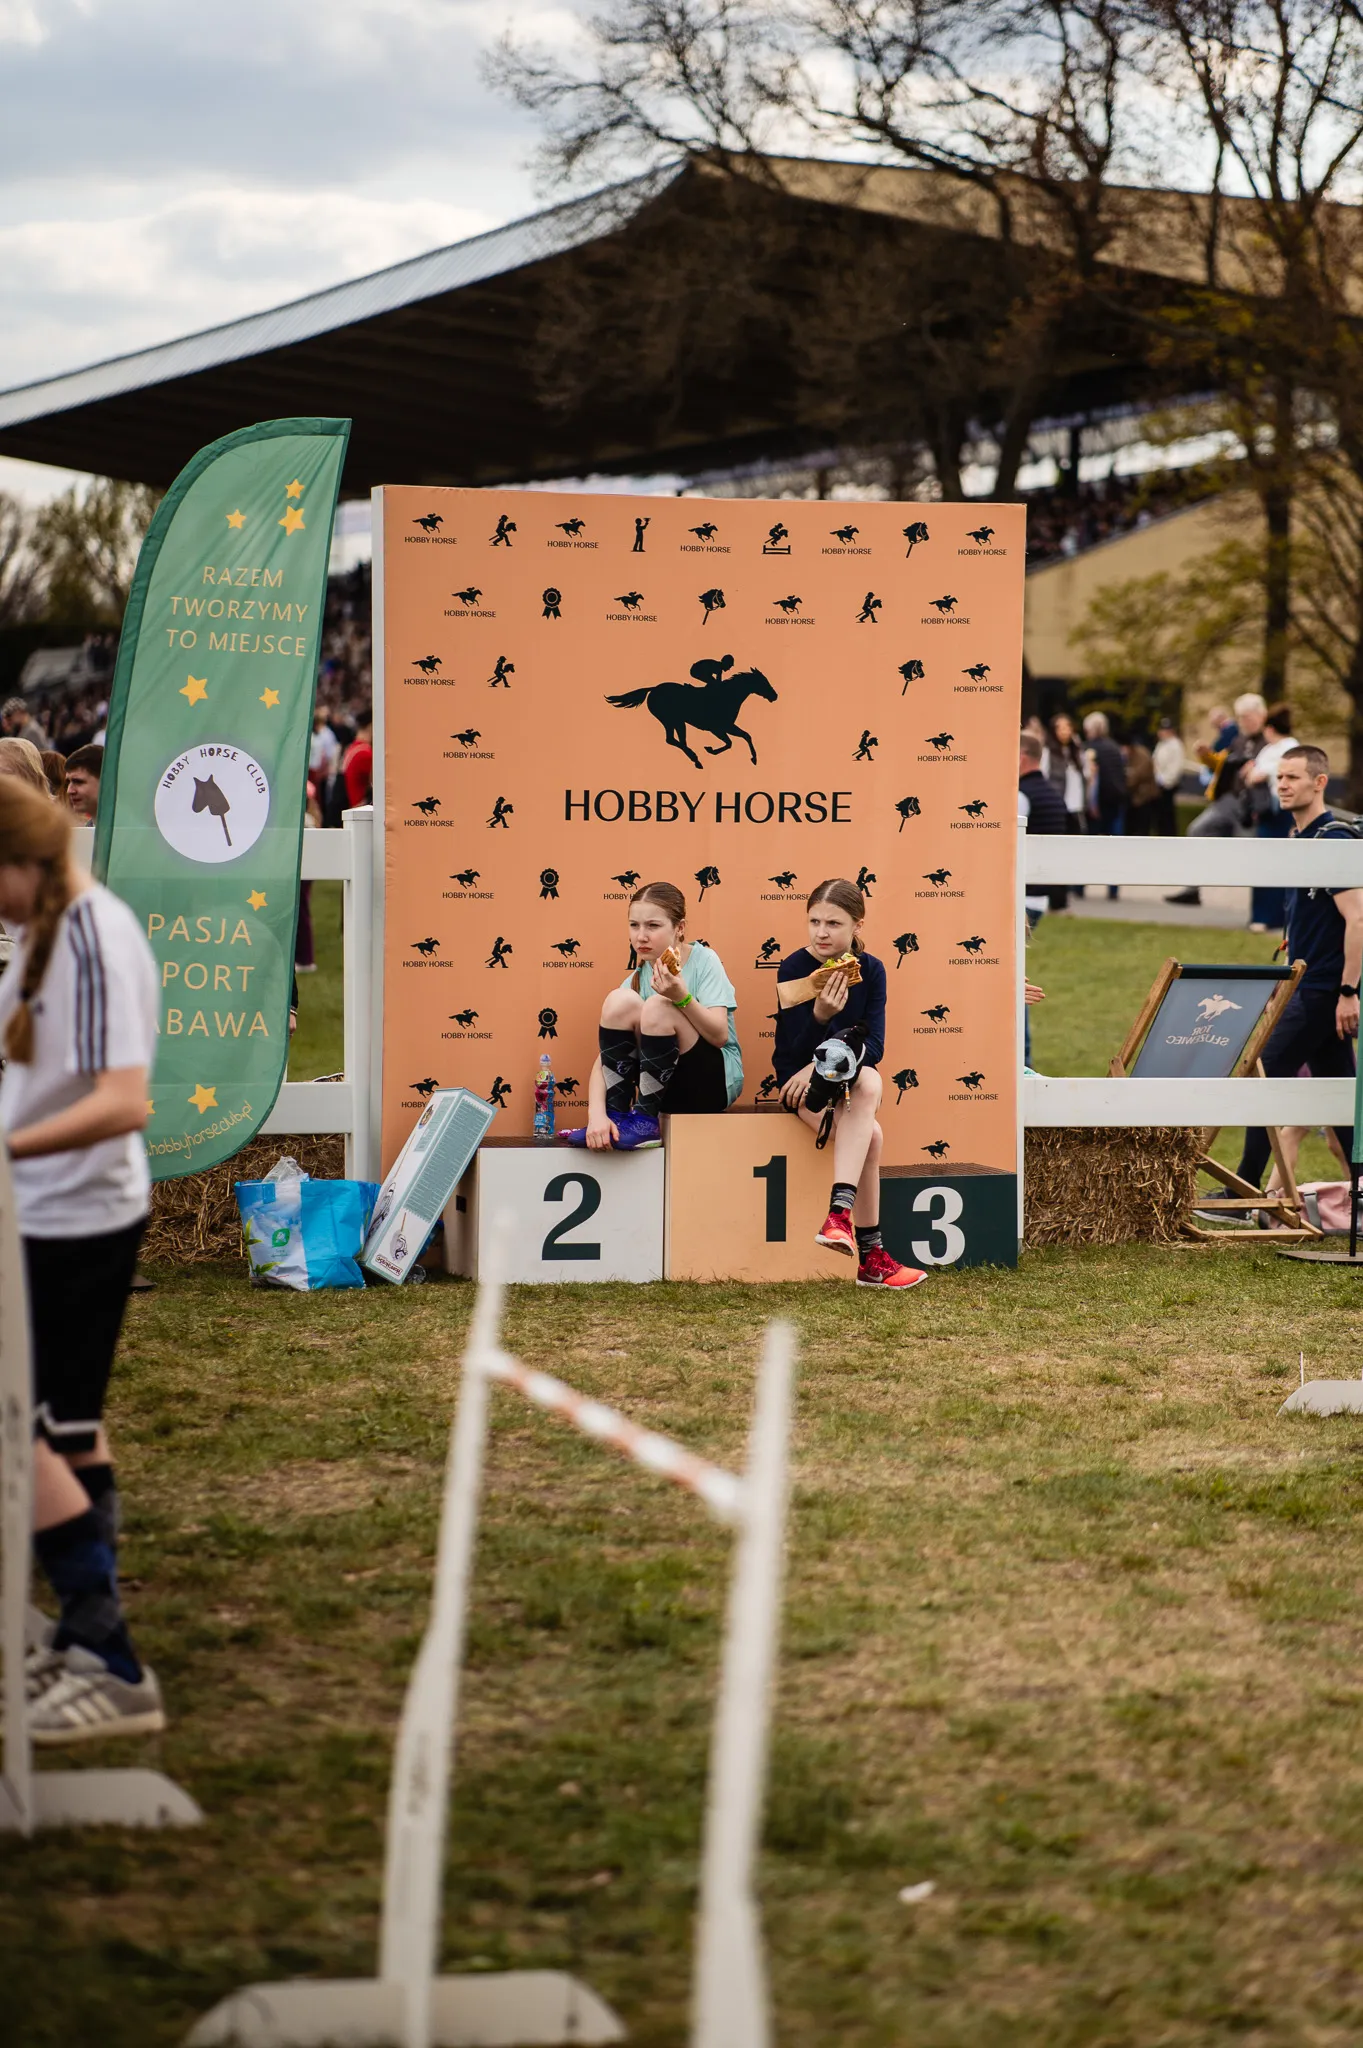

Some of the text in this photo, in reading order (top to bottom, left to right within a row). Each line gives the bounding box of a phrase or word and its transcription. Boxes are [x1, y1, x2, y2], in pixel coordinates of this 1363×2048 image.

[404, 535, 458, 545] HOBBY HORSE
[546, 540, 600, 549] HOBBY HORSE
[679, 544, 732, 554] HOBBY HORSE
[821, 547, 873, 556] HOBBY HORSE
[957, 548, 1008, 556] HOBBY HORSE
[202, 565, 284, 588] RAZEM
[170, 596, 309, 623] TWORZYMY
[443, 609, 497, 619] HOBBY HORSE
[605, 613, 658, 623] HOBBY HORSE
[764, 617, 816, 626] HOBBY HORSE
[920, 617, 972, 625] HOBBY HORSE
[166, 628, 307, 657] TO MIEJSCE
[403, 677, 456, 687] HOBBY HORSE
[953, 684, 1005, 693] HOBBY HORSE
[442, 751, 496, 760] HOBBY HORSE
[917, 754, 968, 763] HOBBY HORSE
[162, 747, 266, 794] HOBBY HORSE CLUB
[564, 789, 853, 824] HOBBY HORSE
[403, 819, 455, 828] HOBBY HORSE
[949, 821, 1002, 830] HOBBY HORSE
[441, 891, 495, 900] HOBBY HORSE
[914, 890, 966, 899] HOBBY HORSE
[147, 913, 252, 946] PASJA
[402, 960, 455, 968] HOBBY HORSE
[542, 960, 595, 969] HOBBY HORSE
[948, 957, 1000, 966] HOBBY HORSE
[161, 961, 256, 992] PORT
[155, 1008, 270, 1038] BAWA
[912, 1026, 964, 1035] HOBBY HORSE
[440, 1031, 494, 1040] HOBBY HORSE
[948, 1093, 1000, 1102] HOBBY HORSE
[554, 1100, 568, 1108] BBY
[753, 1155, 787, 1242] 1
[541, 1172, 601, 1261] 2
[911, 1186, 965, 1266] 3
